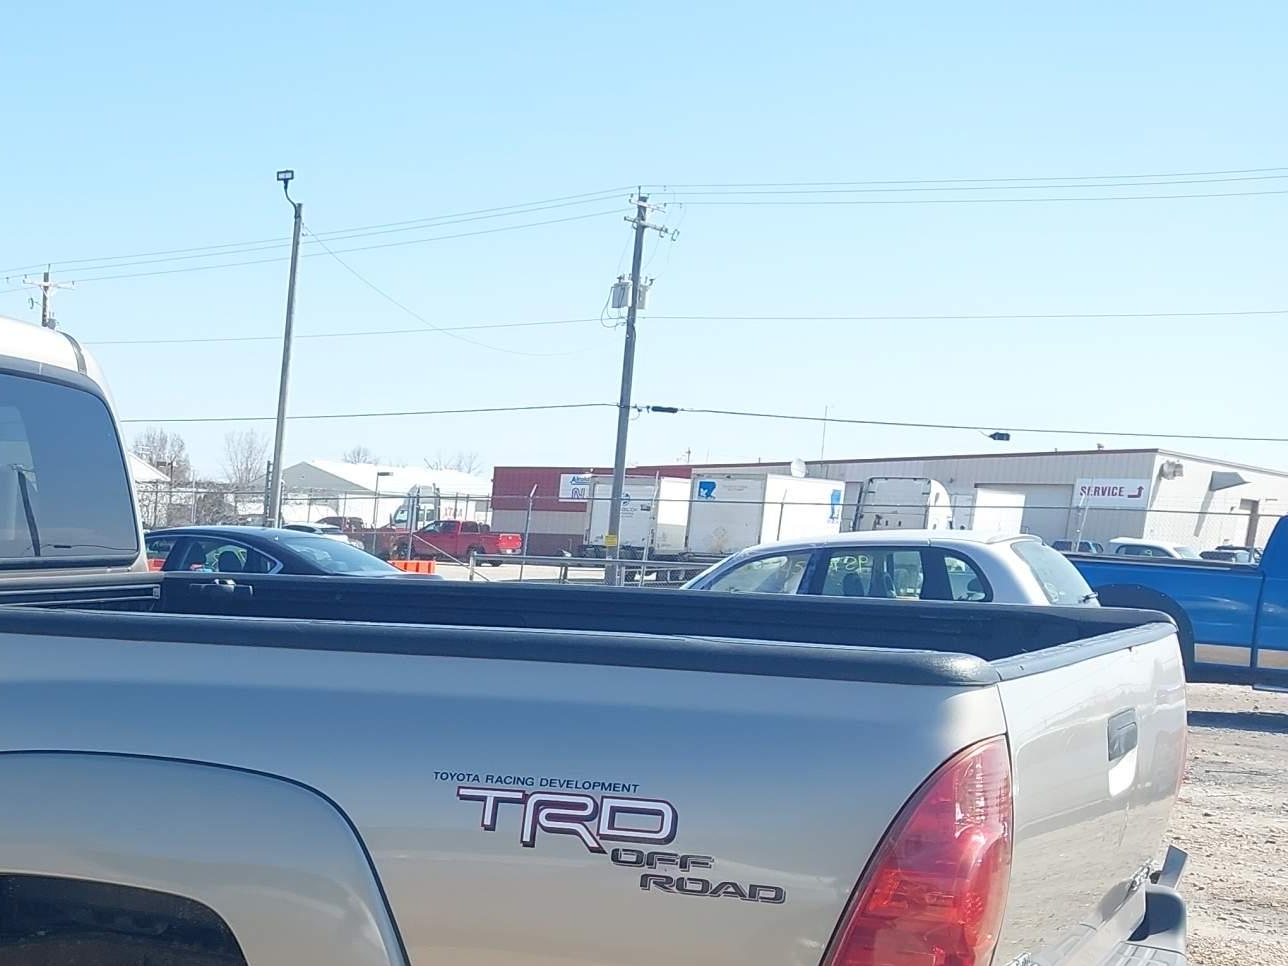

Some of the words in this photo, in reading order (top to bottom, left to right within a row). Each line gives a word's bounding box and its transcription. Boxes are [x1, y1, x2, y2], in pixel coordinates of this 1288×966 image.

[433, 771, 481, 783] TOYOTA
[485, 774, 535, 787] RACING
[539, 777, 640, 793] DEVELOPMENT
[456, 786, 679, 854] TRD
[610, 848, 715, 873] OFF
[639, 873, 787, 904] ROAD
